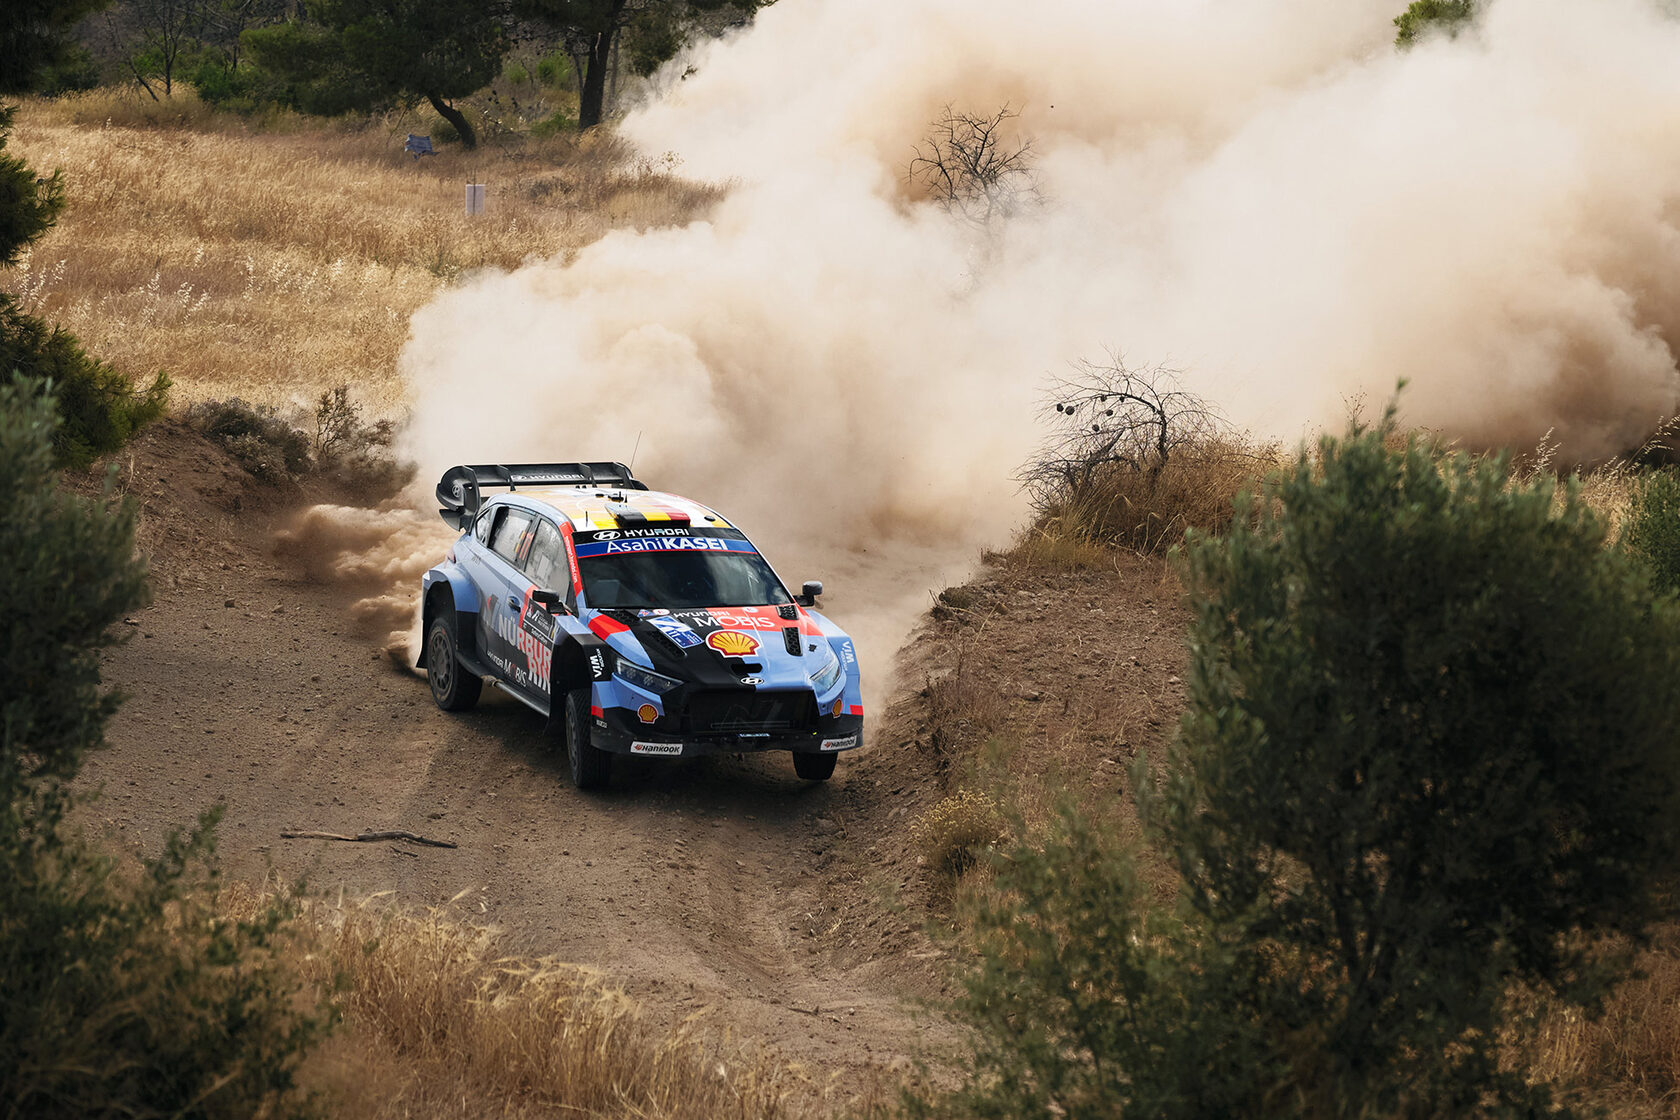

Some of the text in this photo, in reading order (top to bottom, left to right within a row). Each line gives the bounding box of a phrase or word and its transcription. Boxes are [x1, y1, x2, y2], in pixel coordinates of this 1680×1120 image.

[623, 528, 689, 538] HYUNDAI
[673, 610, 730, 618] HYUNDAI
[692, 616, 775, 627] MOBIS
[503, 658, 527, 687] MOBIS
